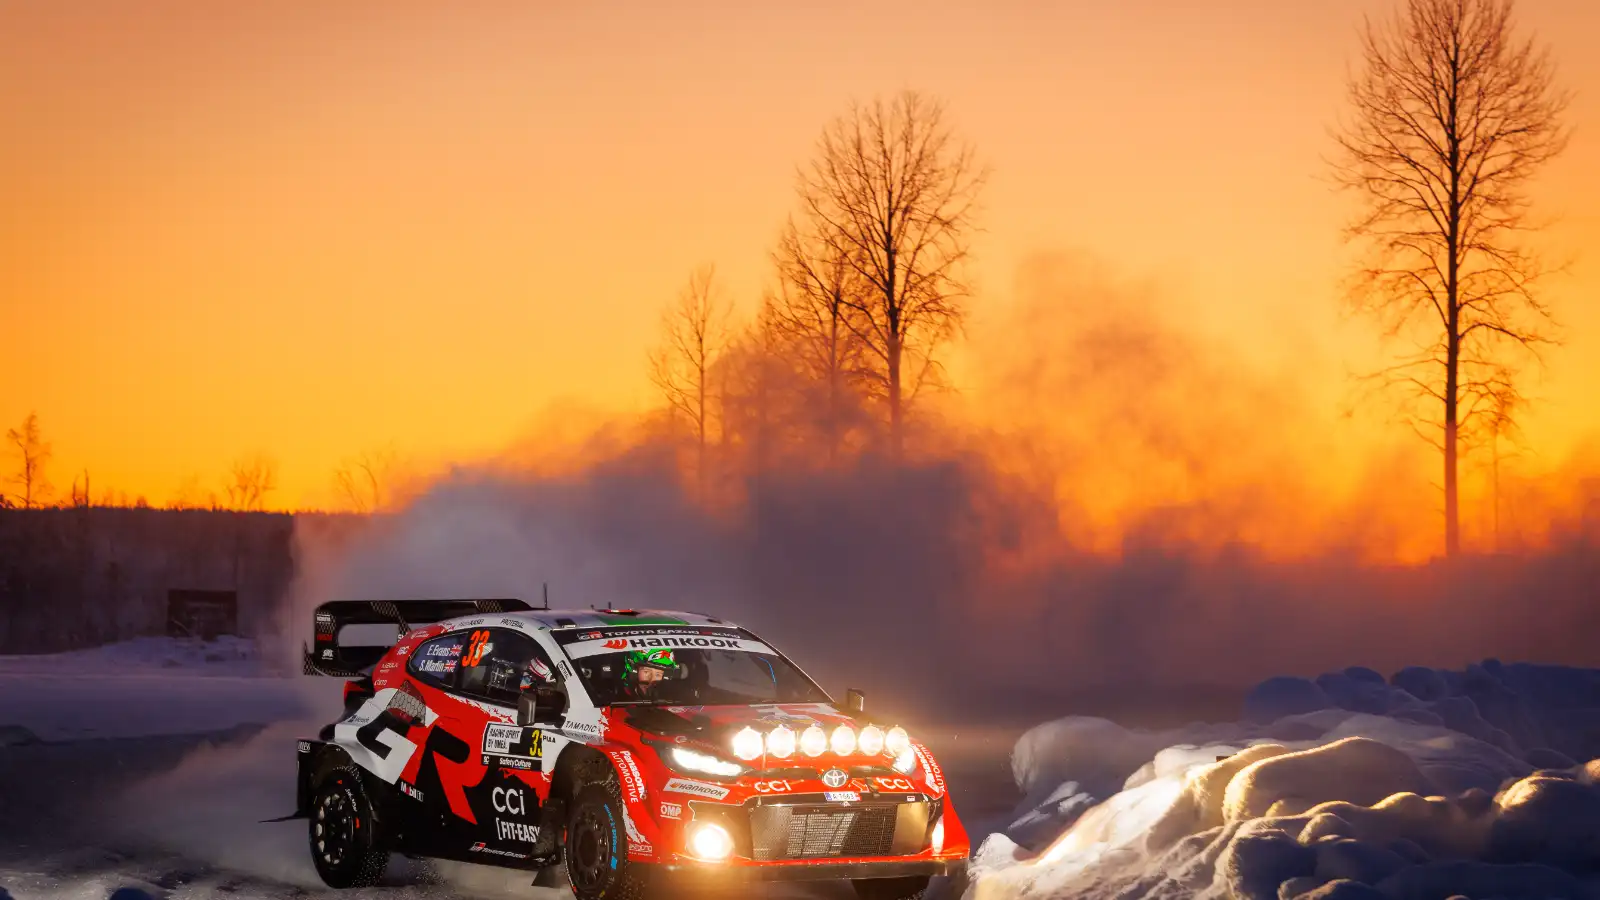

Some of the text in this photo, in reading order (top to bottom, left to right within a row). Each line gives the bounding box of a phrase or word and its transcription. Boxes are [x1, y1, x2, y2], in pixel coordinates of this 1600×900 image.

[605, 629, 654, 637] TOYOTA
[426, 644, 451, 657] E.Evans
[461, 630, 491, 667] 33
[418, 659, 445, 673] S.Martin
[565, 720, 598, 733] TAMADIC
[609, 751, 639, 804] AUTOMOTIVE
[619, 750, 647, 800] Panasonic
[660, 805, 682, 816] OMP
